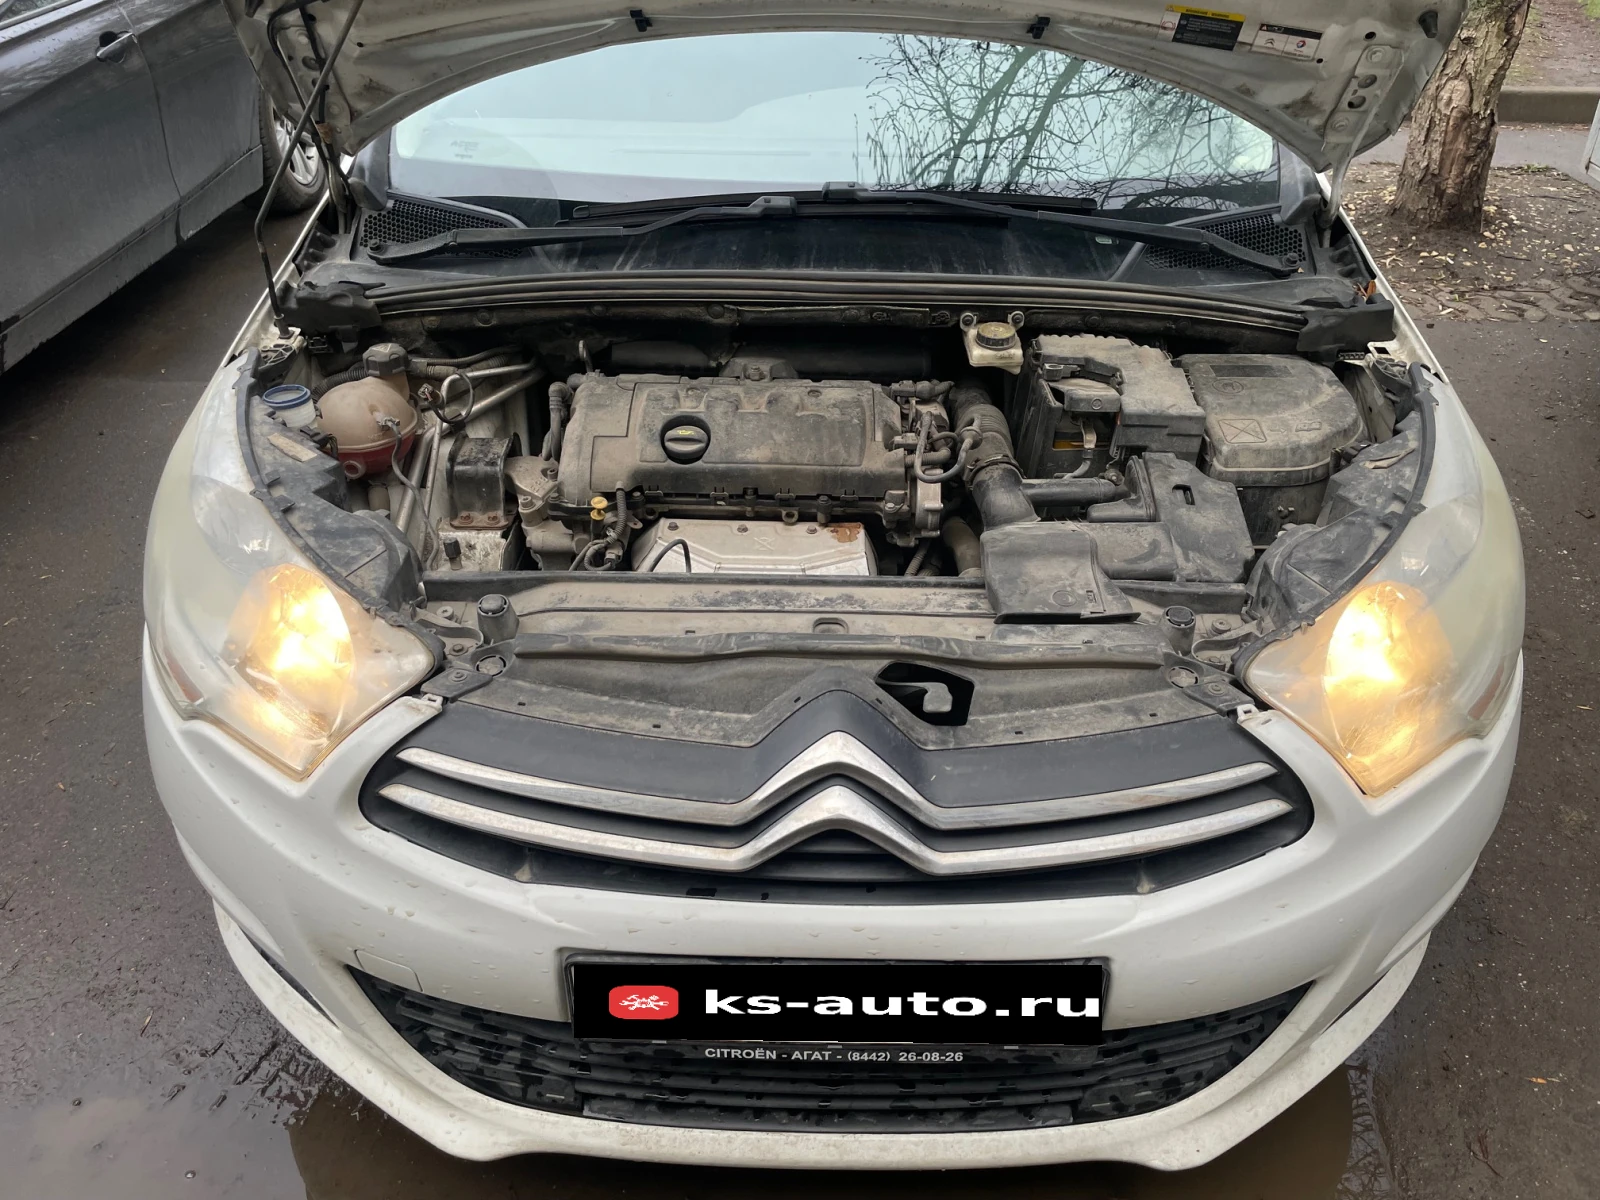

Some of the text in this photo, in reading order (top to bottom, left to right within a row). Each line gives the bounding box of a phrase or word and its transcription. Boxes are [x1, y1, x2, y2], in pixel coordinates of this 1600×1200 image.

[704, 1047, 777, 1060] CITROËN
[847, 1050, 891, 1062] (8442)
[898, 1051, 964, 1062] 26-08-26
